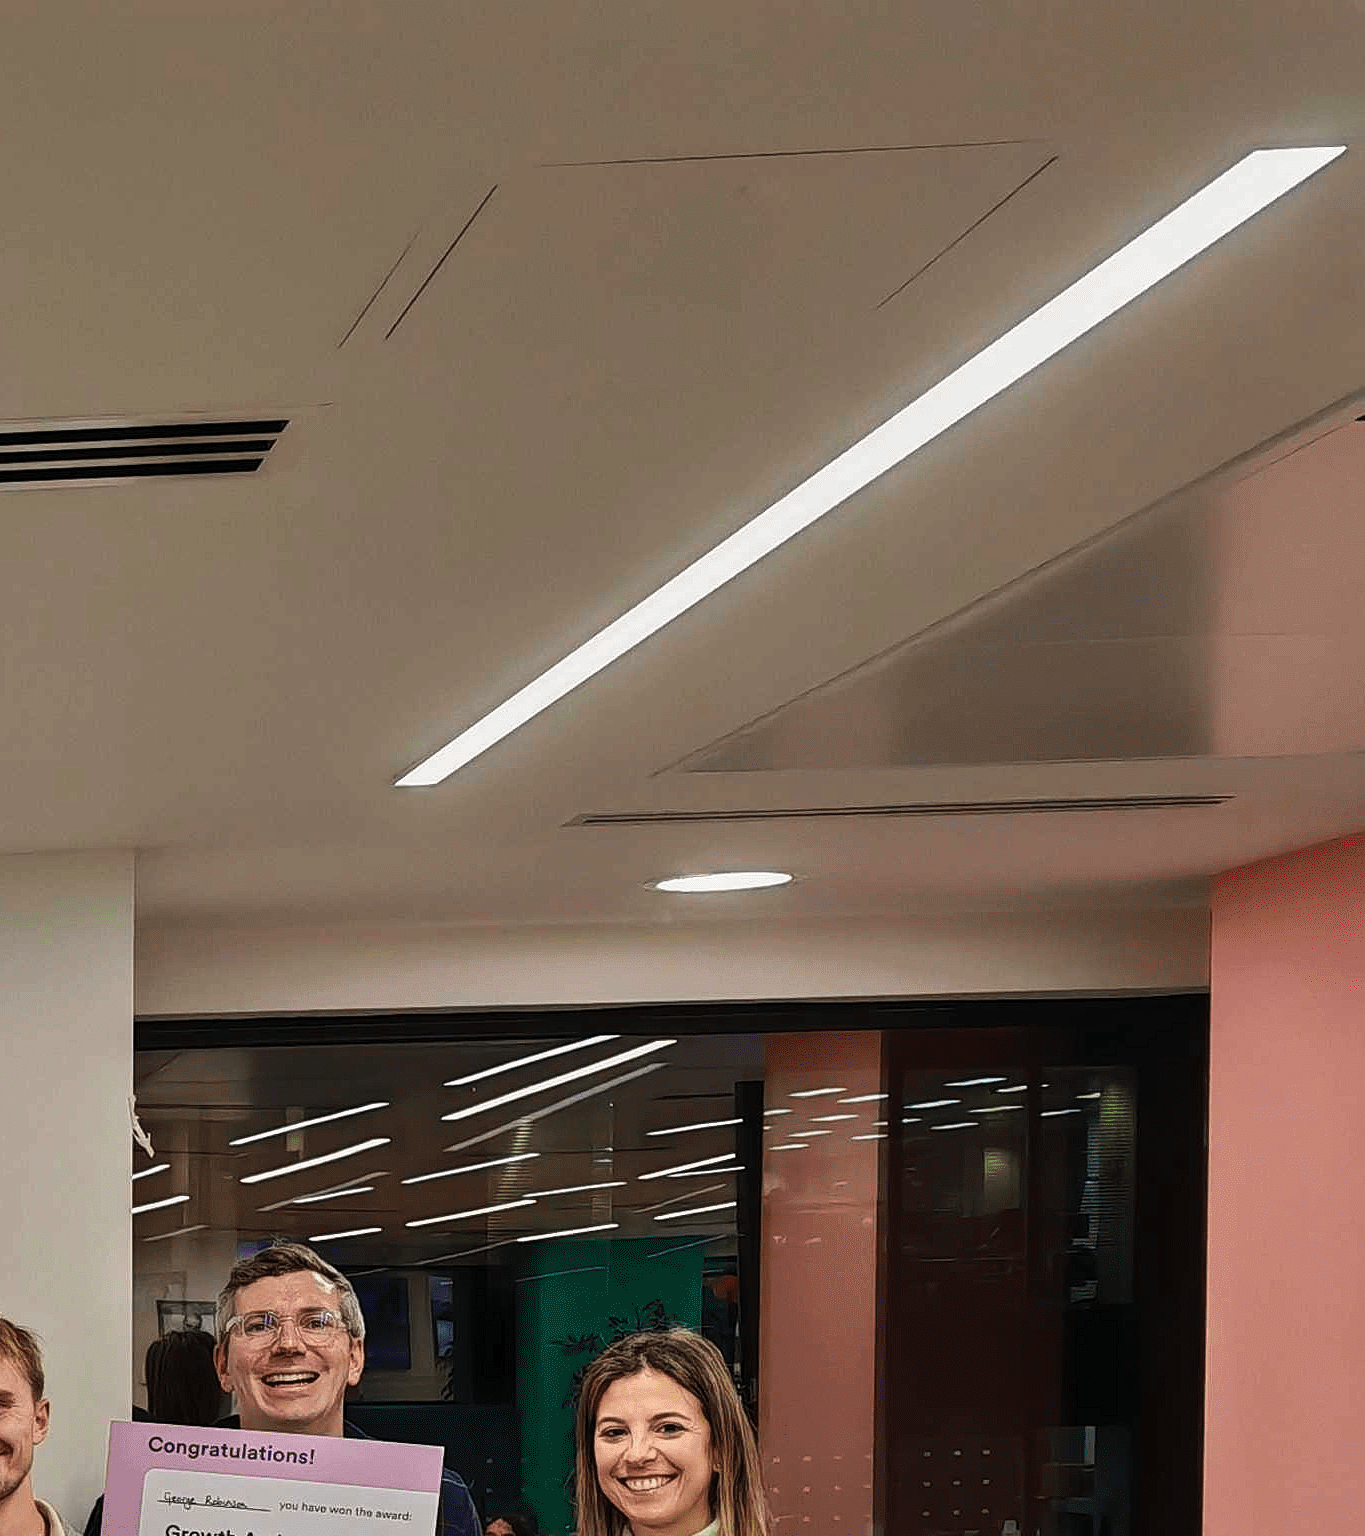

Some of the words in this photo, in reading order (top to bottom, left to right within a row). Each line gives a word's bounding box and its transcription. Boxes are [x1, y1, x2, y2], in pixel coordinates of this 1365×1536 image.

[148, 1436, 315, 1465] Congratulations!
[279, 1502, 299, 1511] you
[301, 1502, 327, 1514] have
[328, 1506, 353, 1516] won
[355, 1506, 373, 1518] the
[375, 1510, 412, 1521] award:
